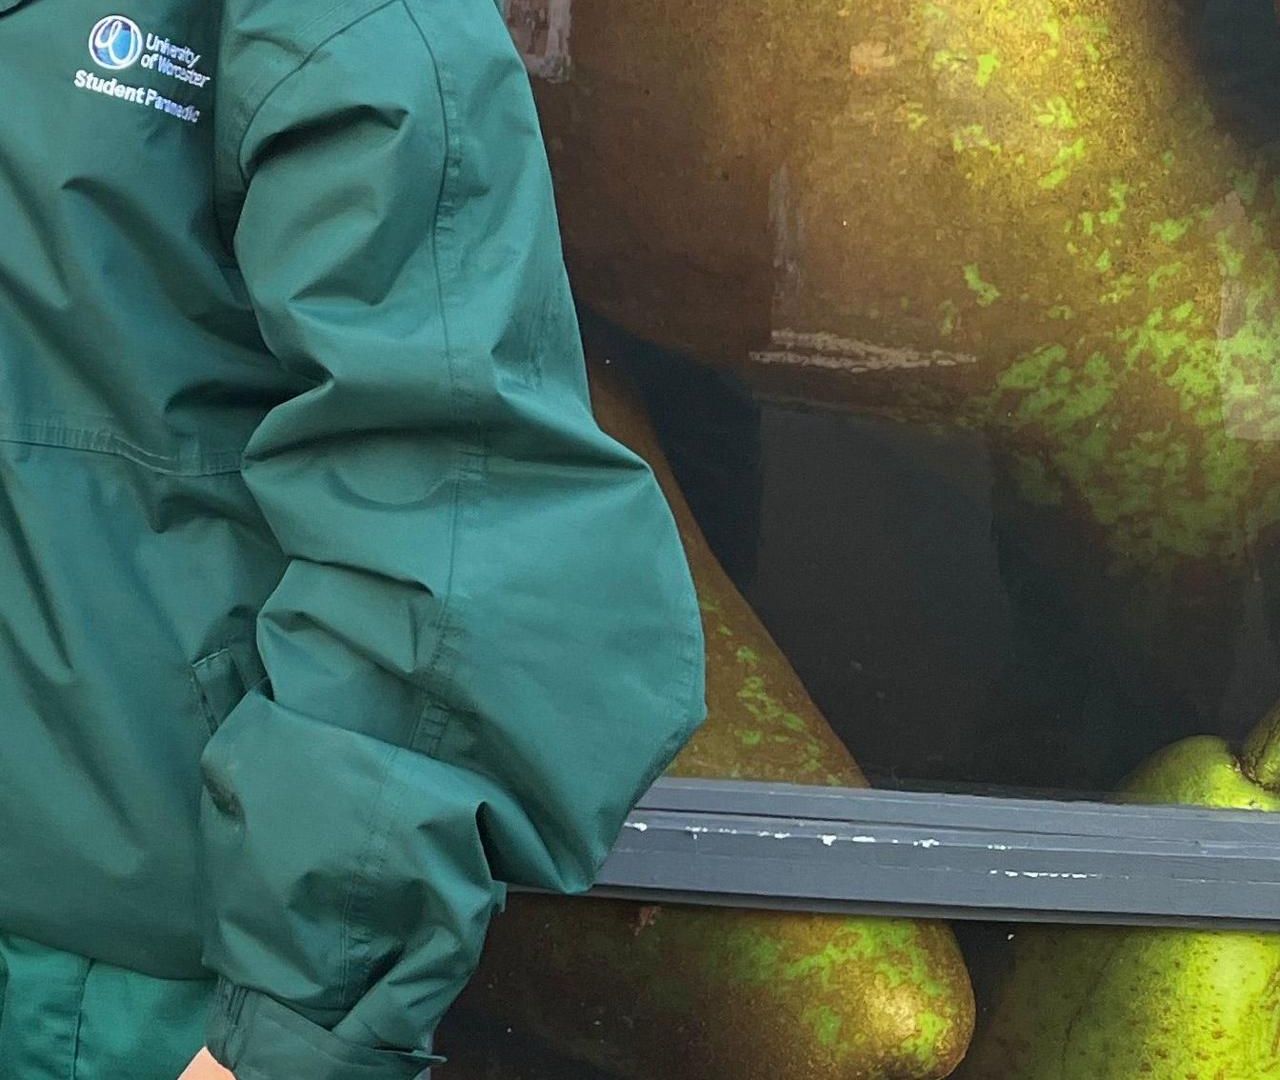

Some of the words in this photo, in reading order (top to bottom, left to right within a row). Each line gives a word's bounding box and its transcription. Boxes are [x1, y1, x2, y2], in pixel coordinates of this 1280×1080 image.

[145, 32, 201, 69] University
[140, 53, 159, 69] of
[157, 55, 211, 88] Worcester
[73, 69, 147, 105] Student
[144, 88, 201, 123] Paramedic
